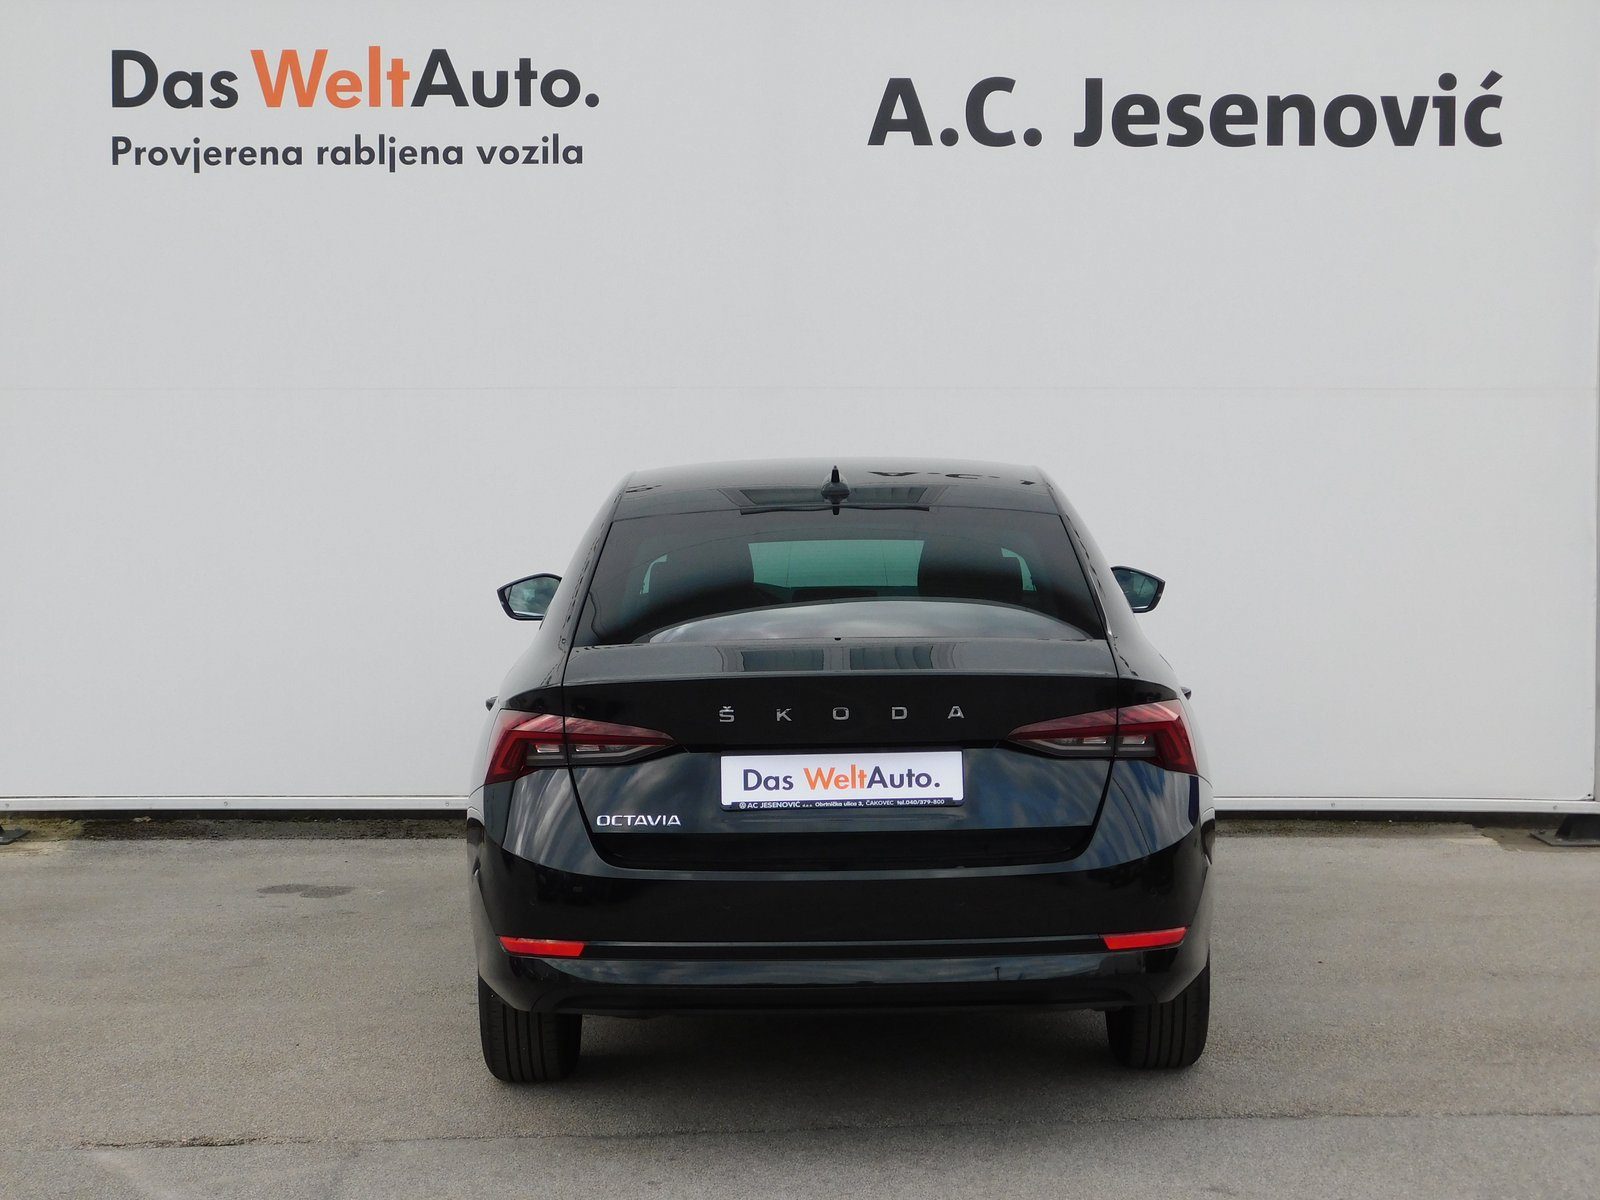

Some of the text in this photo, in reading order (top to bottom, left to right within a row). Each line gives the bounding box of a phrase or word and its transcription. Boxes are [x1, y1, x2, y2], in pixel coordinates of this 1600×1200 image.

[111, 45, 600, 110] Das WeltAuto.
[867, 69, 1503, 148] A.C. Jesenović
[111, 132, 583, 174] Provjerena rabljena vozila
[718, 704, 965, 724] ŠKODA
[743, 764, 942, 793] Das WeltAuto.
[596, 814, 682, 828] OCTAVIA
